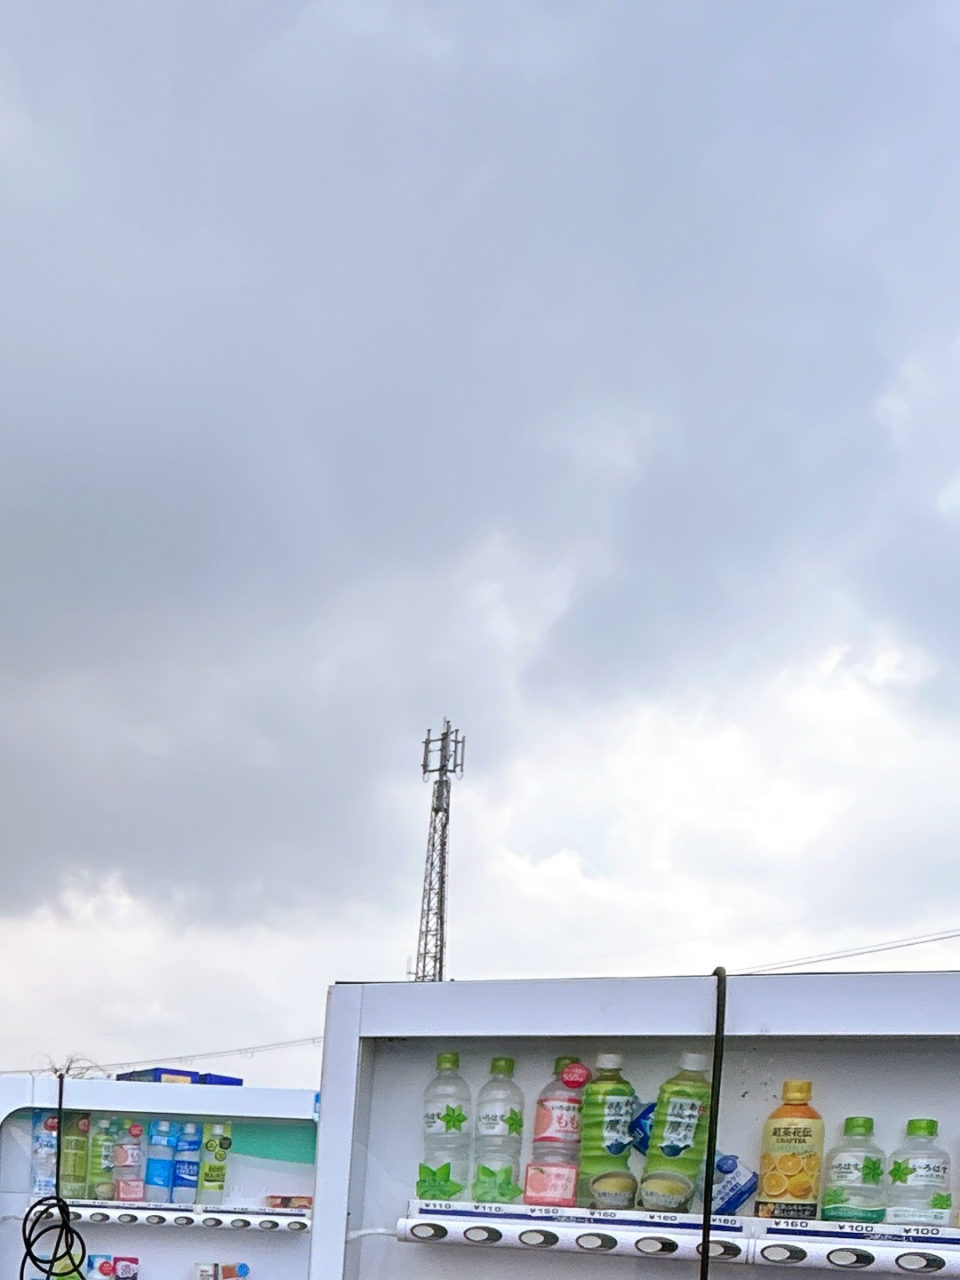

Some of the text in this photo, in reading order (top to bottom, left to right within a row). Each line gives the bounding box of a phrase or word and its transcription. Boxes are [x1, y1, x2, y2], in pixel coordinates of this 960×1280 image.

[557, 1113, 579, 1129] もも
[771, 1127, 813, 1138] 紅茶花伝
